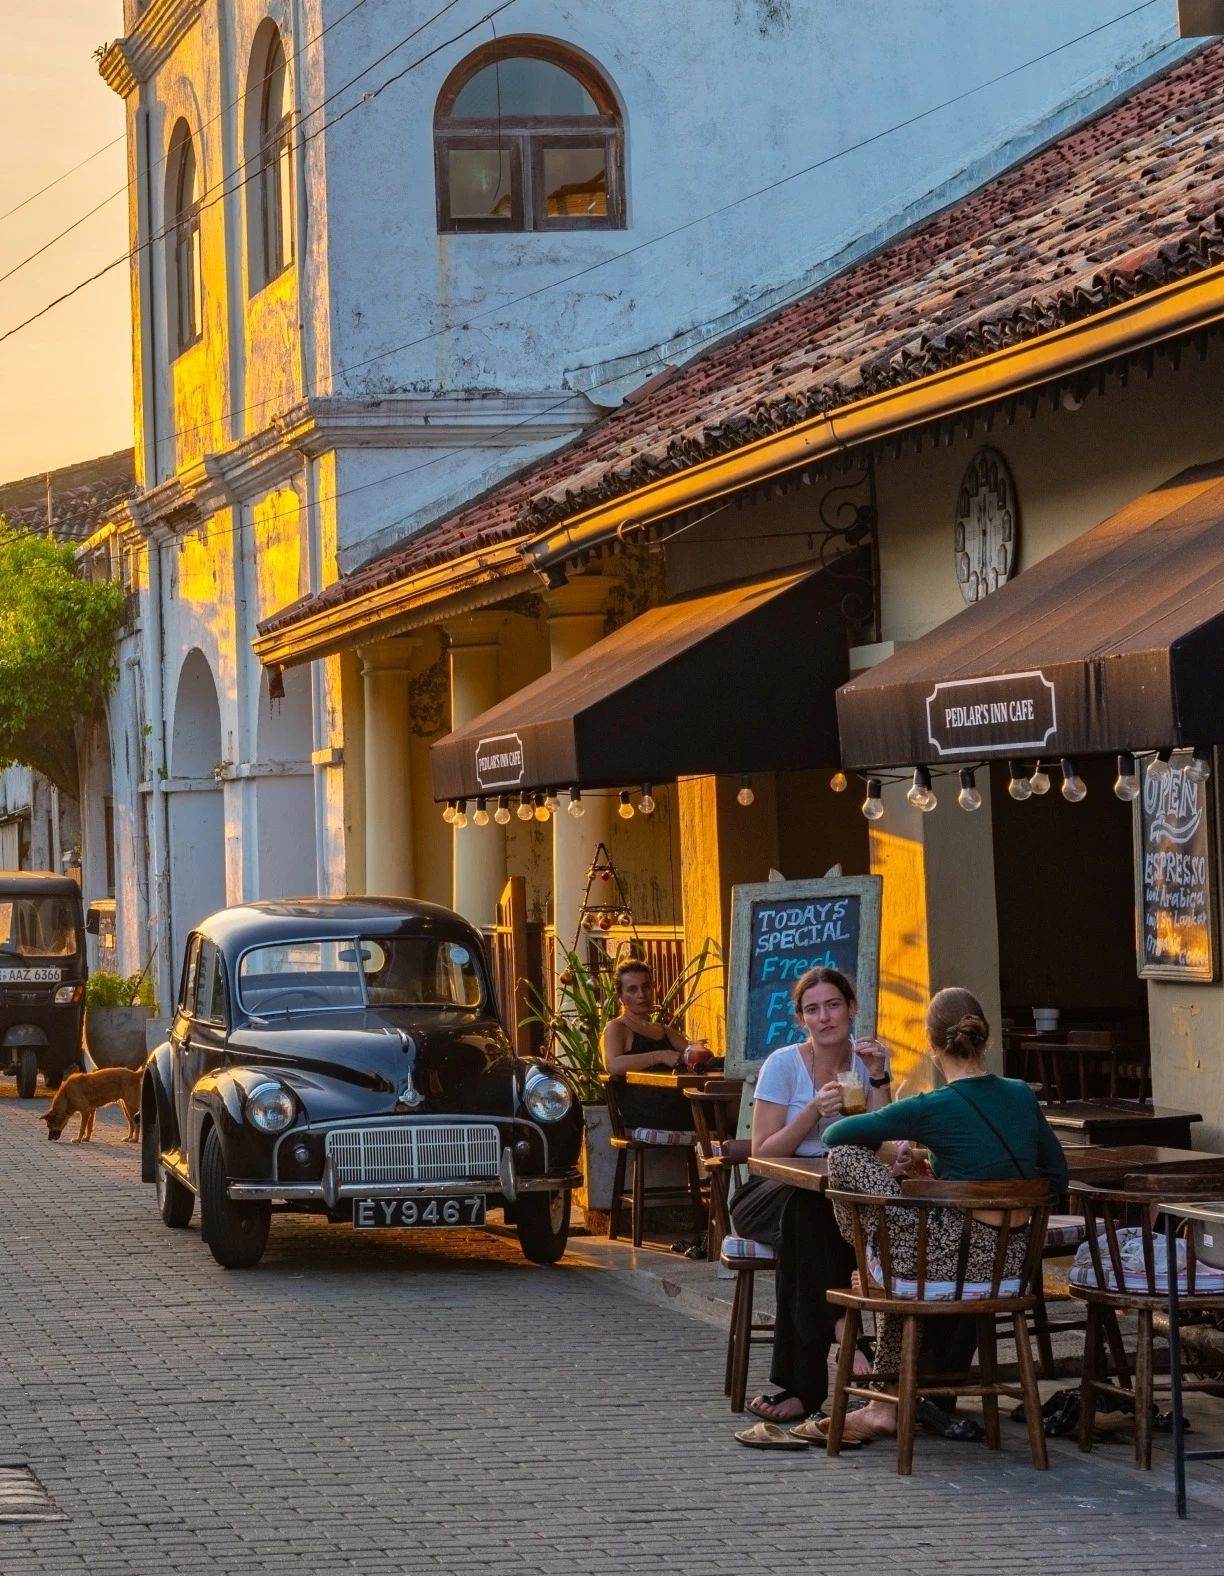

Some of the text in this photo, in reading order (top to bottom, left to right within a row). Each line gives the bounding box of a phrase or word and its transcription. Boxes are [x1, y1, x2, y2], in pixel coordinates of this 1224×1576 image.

[945, 700, 1034, 729] PEDLAR'S INN CAFE
[478, 751, 521, 772] PEDLAR'S INN CAFE
[1144, 768, 1197, 818] OPEN
[1144, 851, 1206, 887] ESPRESSO
[1160, 884, 1205, 908] Arabica
[759, 899, 848, 932] TODAYS
[755, 920, 850, 956] SPECIAL
[8, 970, 31, 981] AAZ
[34, 969, 60, 981] 6366
[359, 1199, 481, 1225] EY9467
